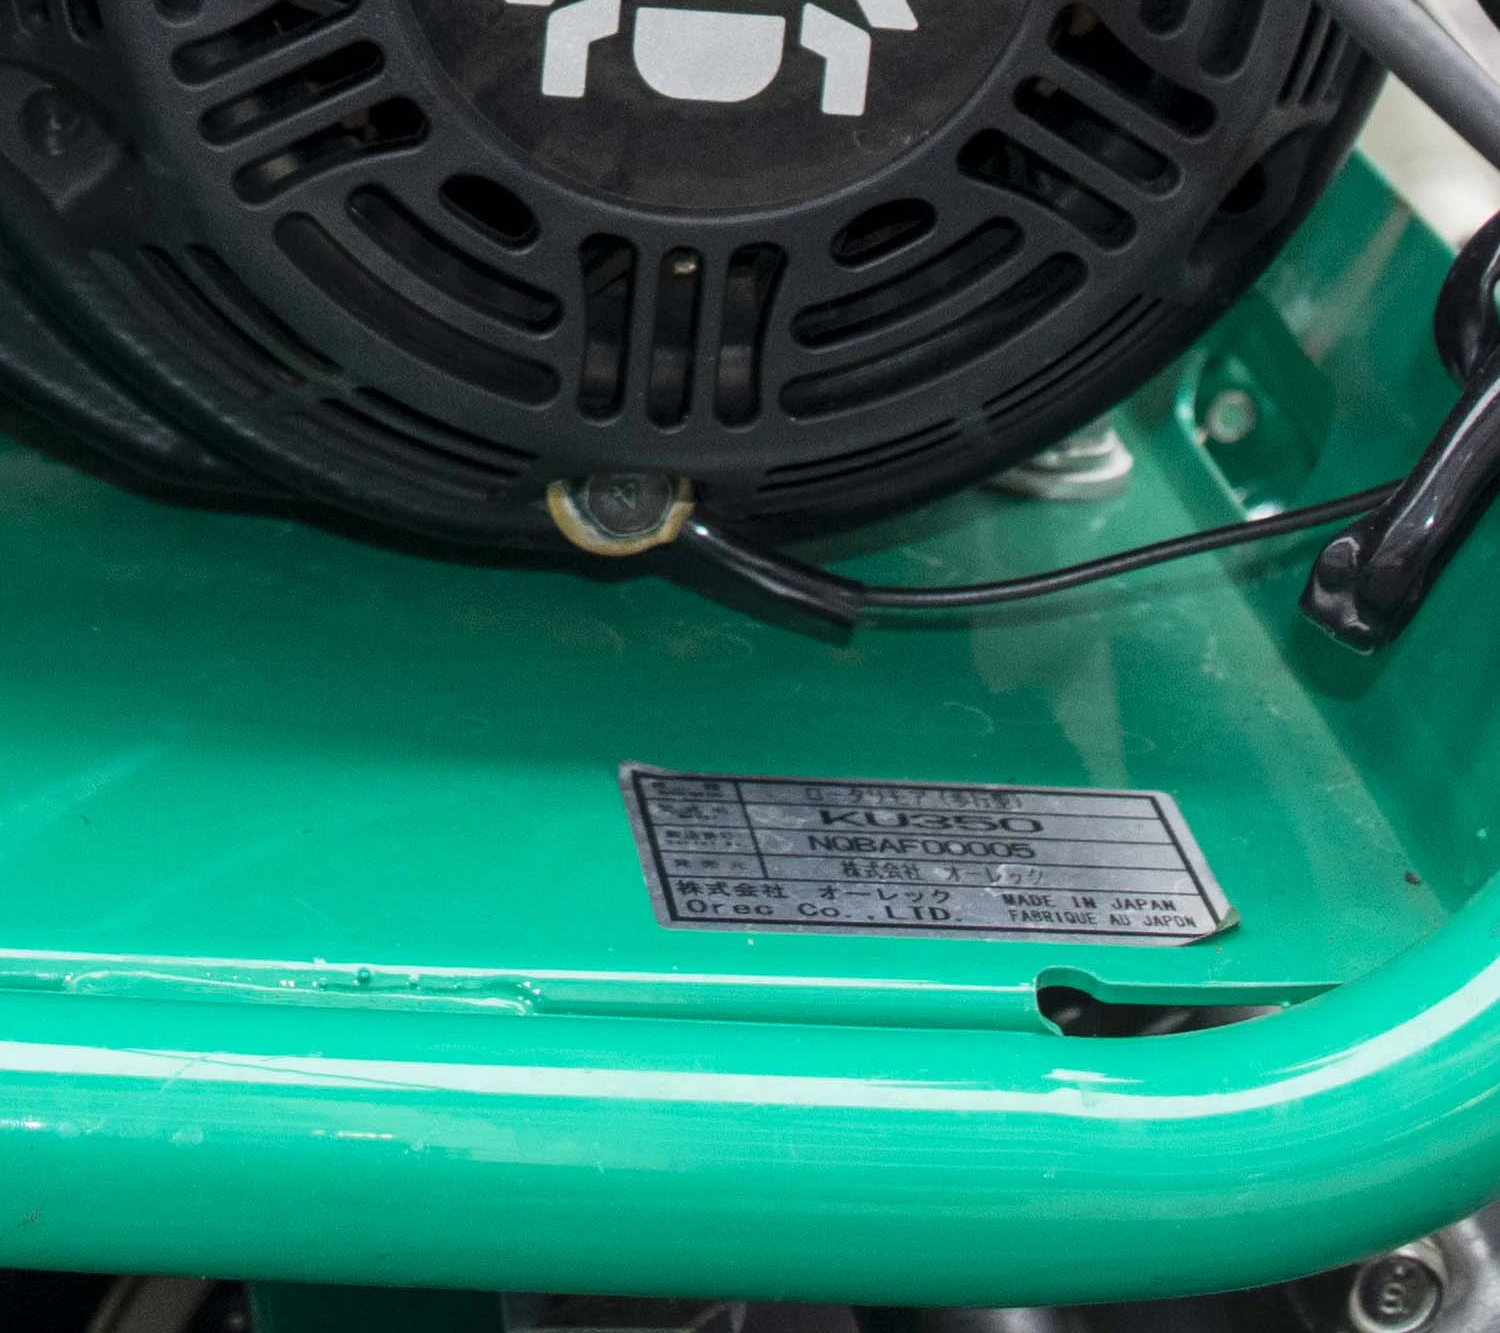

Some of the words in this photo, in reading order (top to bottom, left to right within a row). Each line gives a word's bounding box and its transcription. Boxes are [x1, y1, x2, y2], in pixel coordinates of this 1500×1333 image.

[818, 809, 1044, 834] KU350
[676, 879, 789, 901] 株式会社
[818, 884, 952, 904] オーレック
[685, 898, 775, 916] Orec
[1001, 893, 1056, 909] MADE
[1071, 895, 1098, 910] IN
[1111, 897, 1178, 912] JAPAN
[1009, 910, 1098, 926] FABRIQUE
[1109, 913, 1132, 927] AU
[1143, 915, 1198, 928] JAPON
